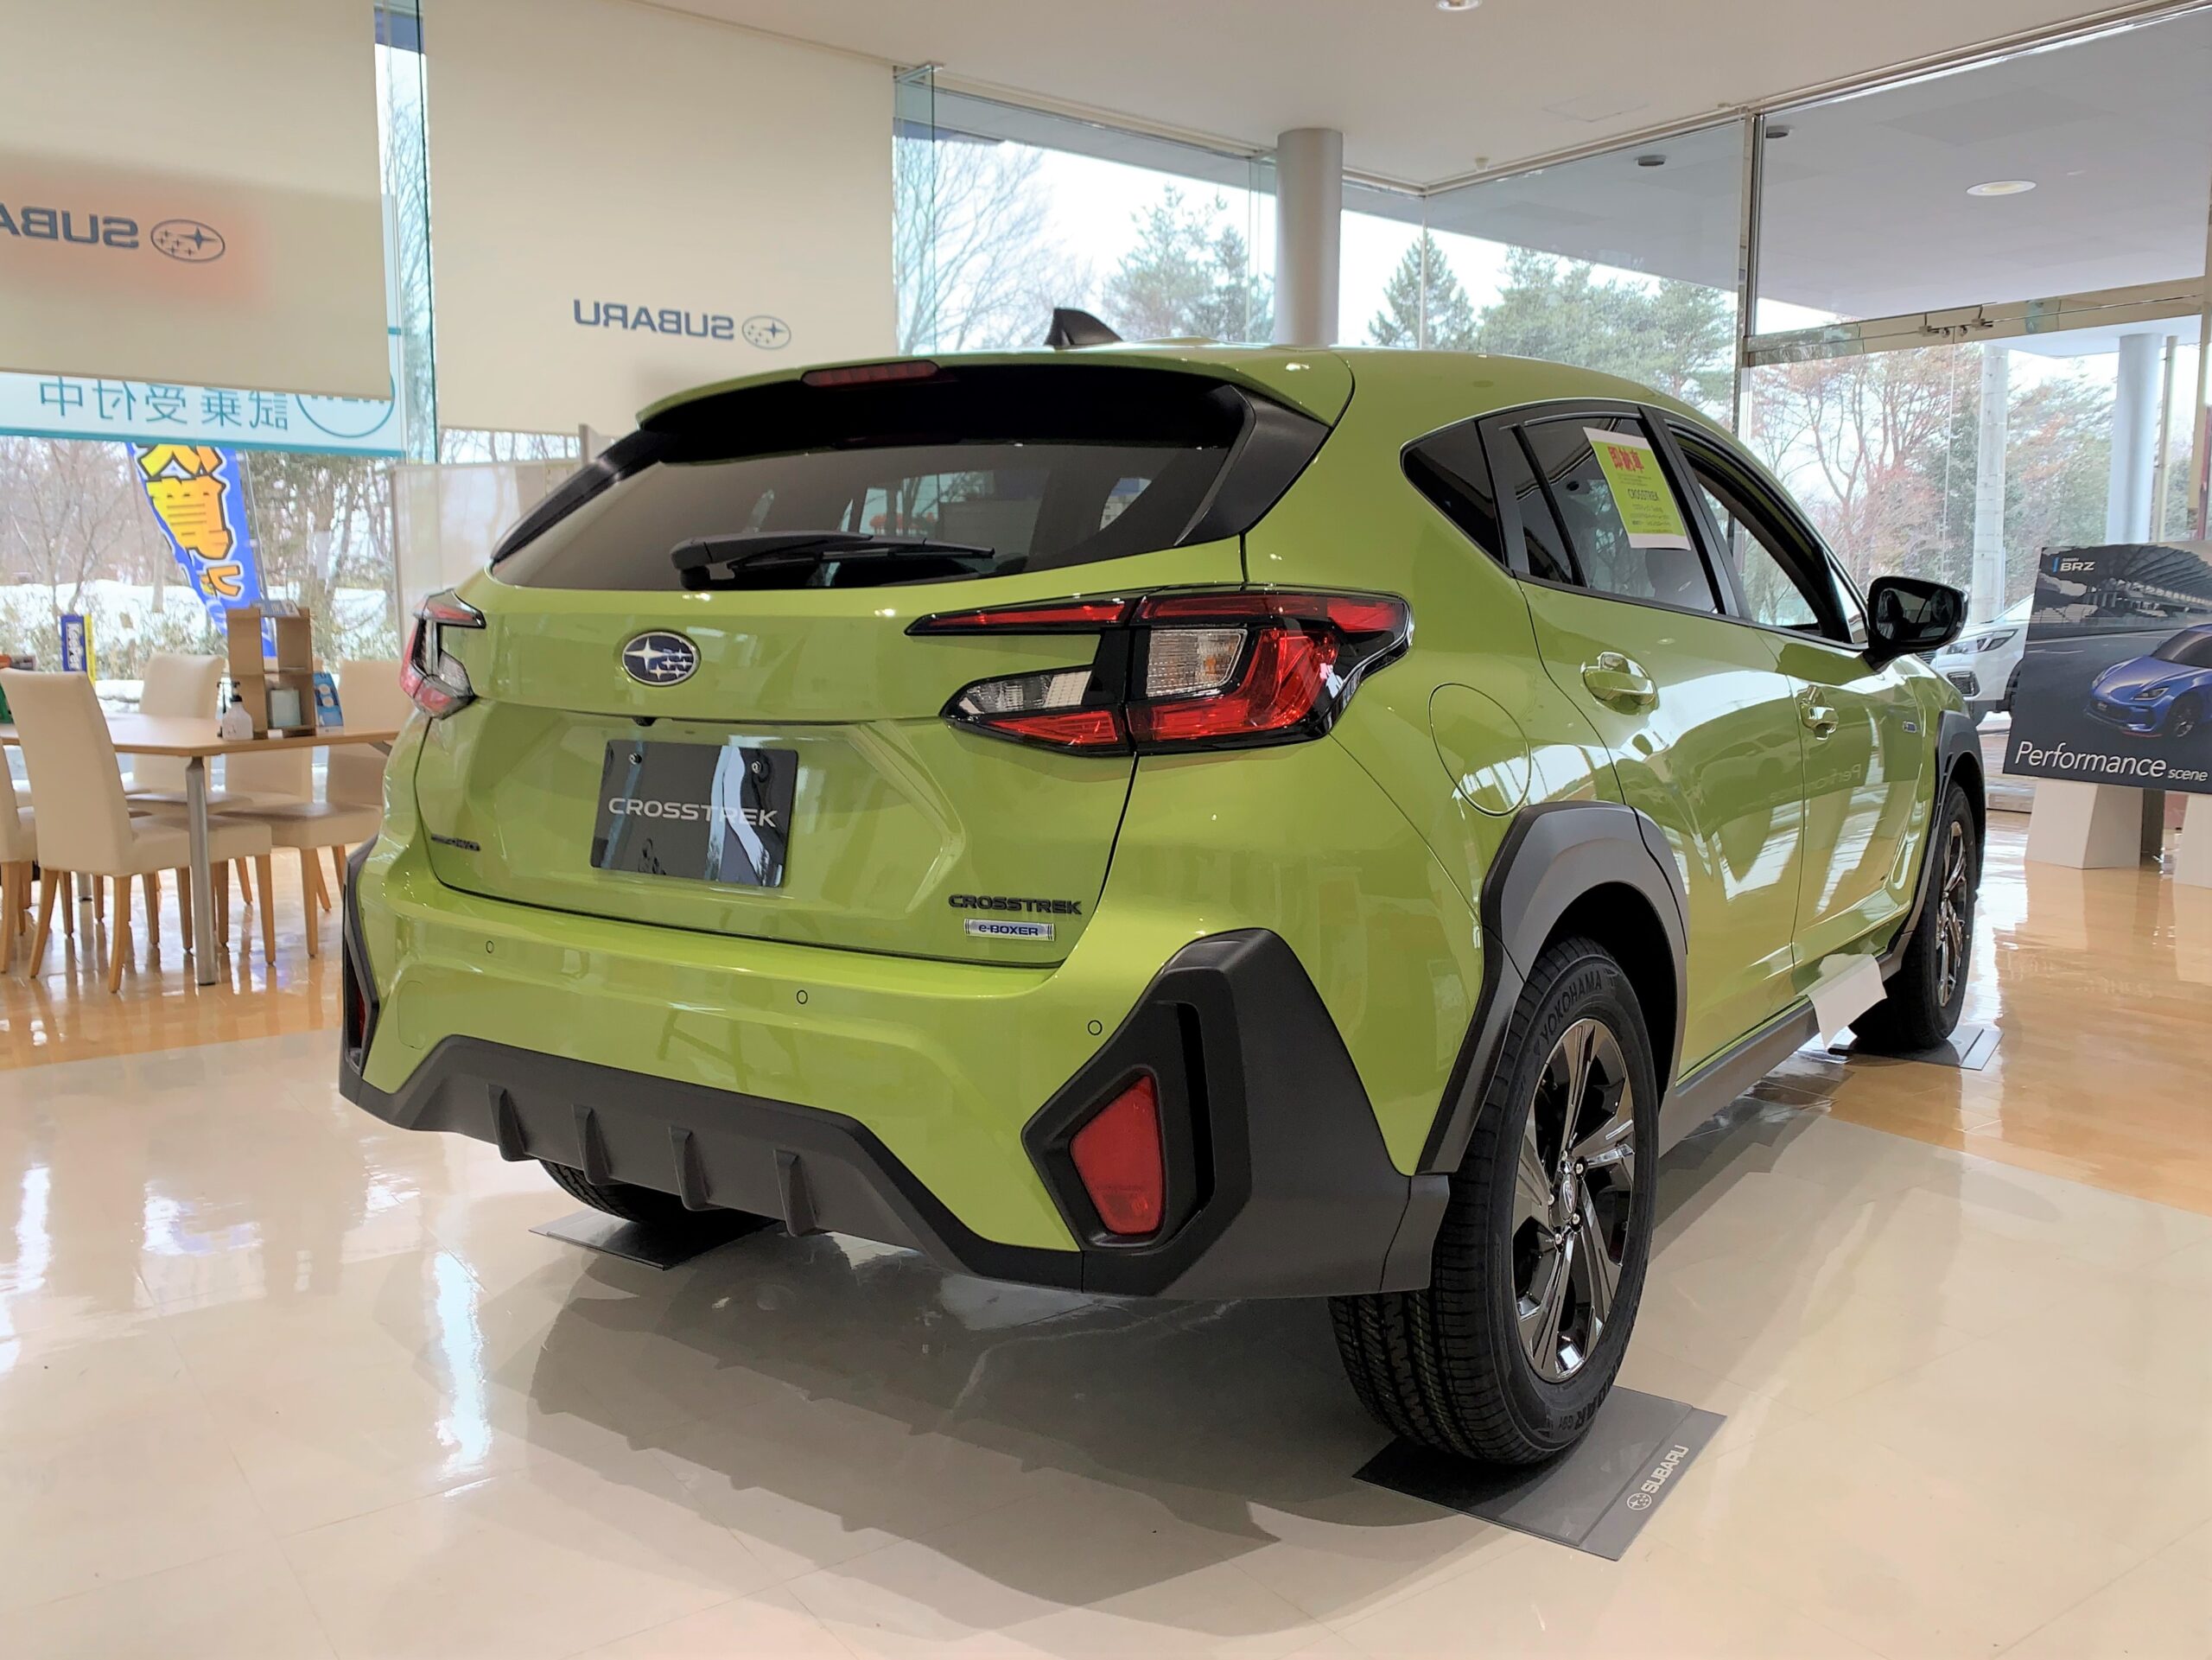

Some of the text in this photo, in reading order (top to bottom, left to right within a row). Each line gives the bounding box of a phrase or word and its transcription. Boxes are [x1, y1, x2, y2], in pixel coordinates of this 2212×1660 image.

[2060, 562, 2095, 571] BRZ
[2015, 741, 2209, 781] Performance scene
[608, 798, 778, 828] CROSSTREK
[949, 894, 1082, 914] CROSSTREK
[979, 925, 1038, 936] e-BOXER
[1540, 970, 1602, 1045] YOKOHAMA
[1641, 1445, 1689, 1493] SUBARU
